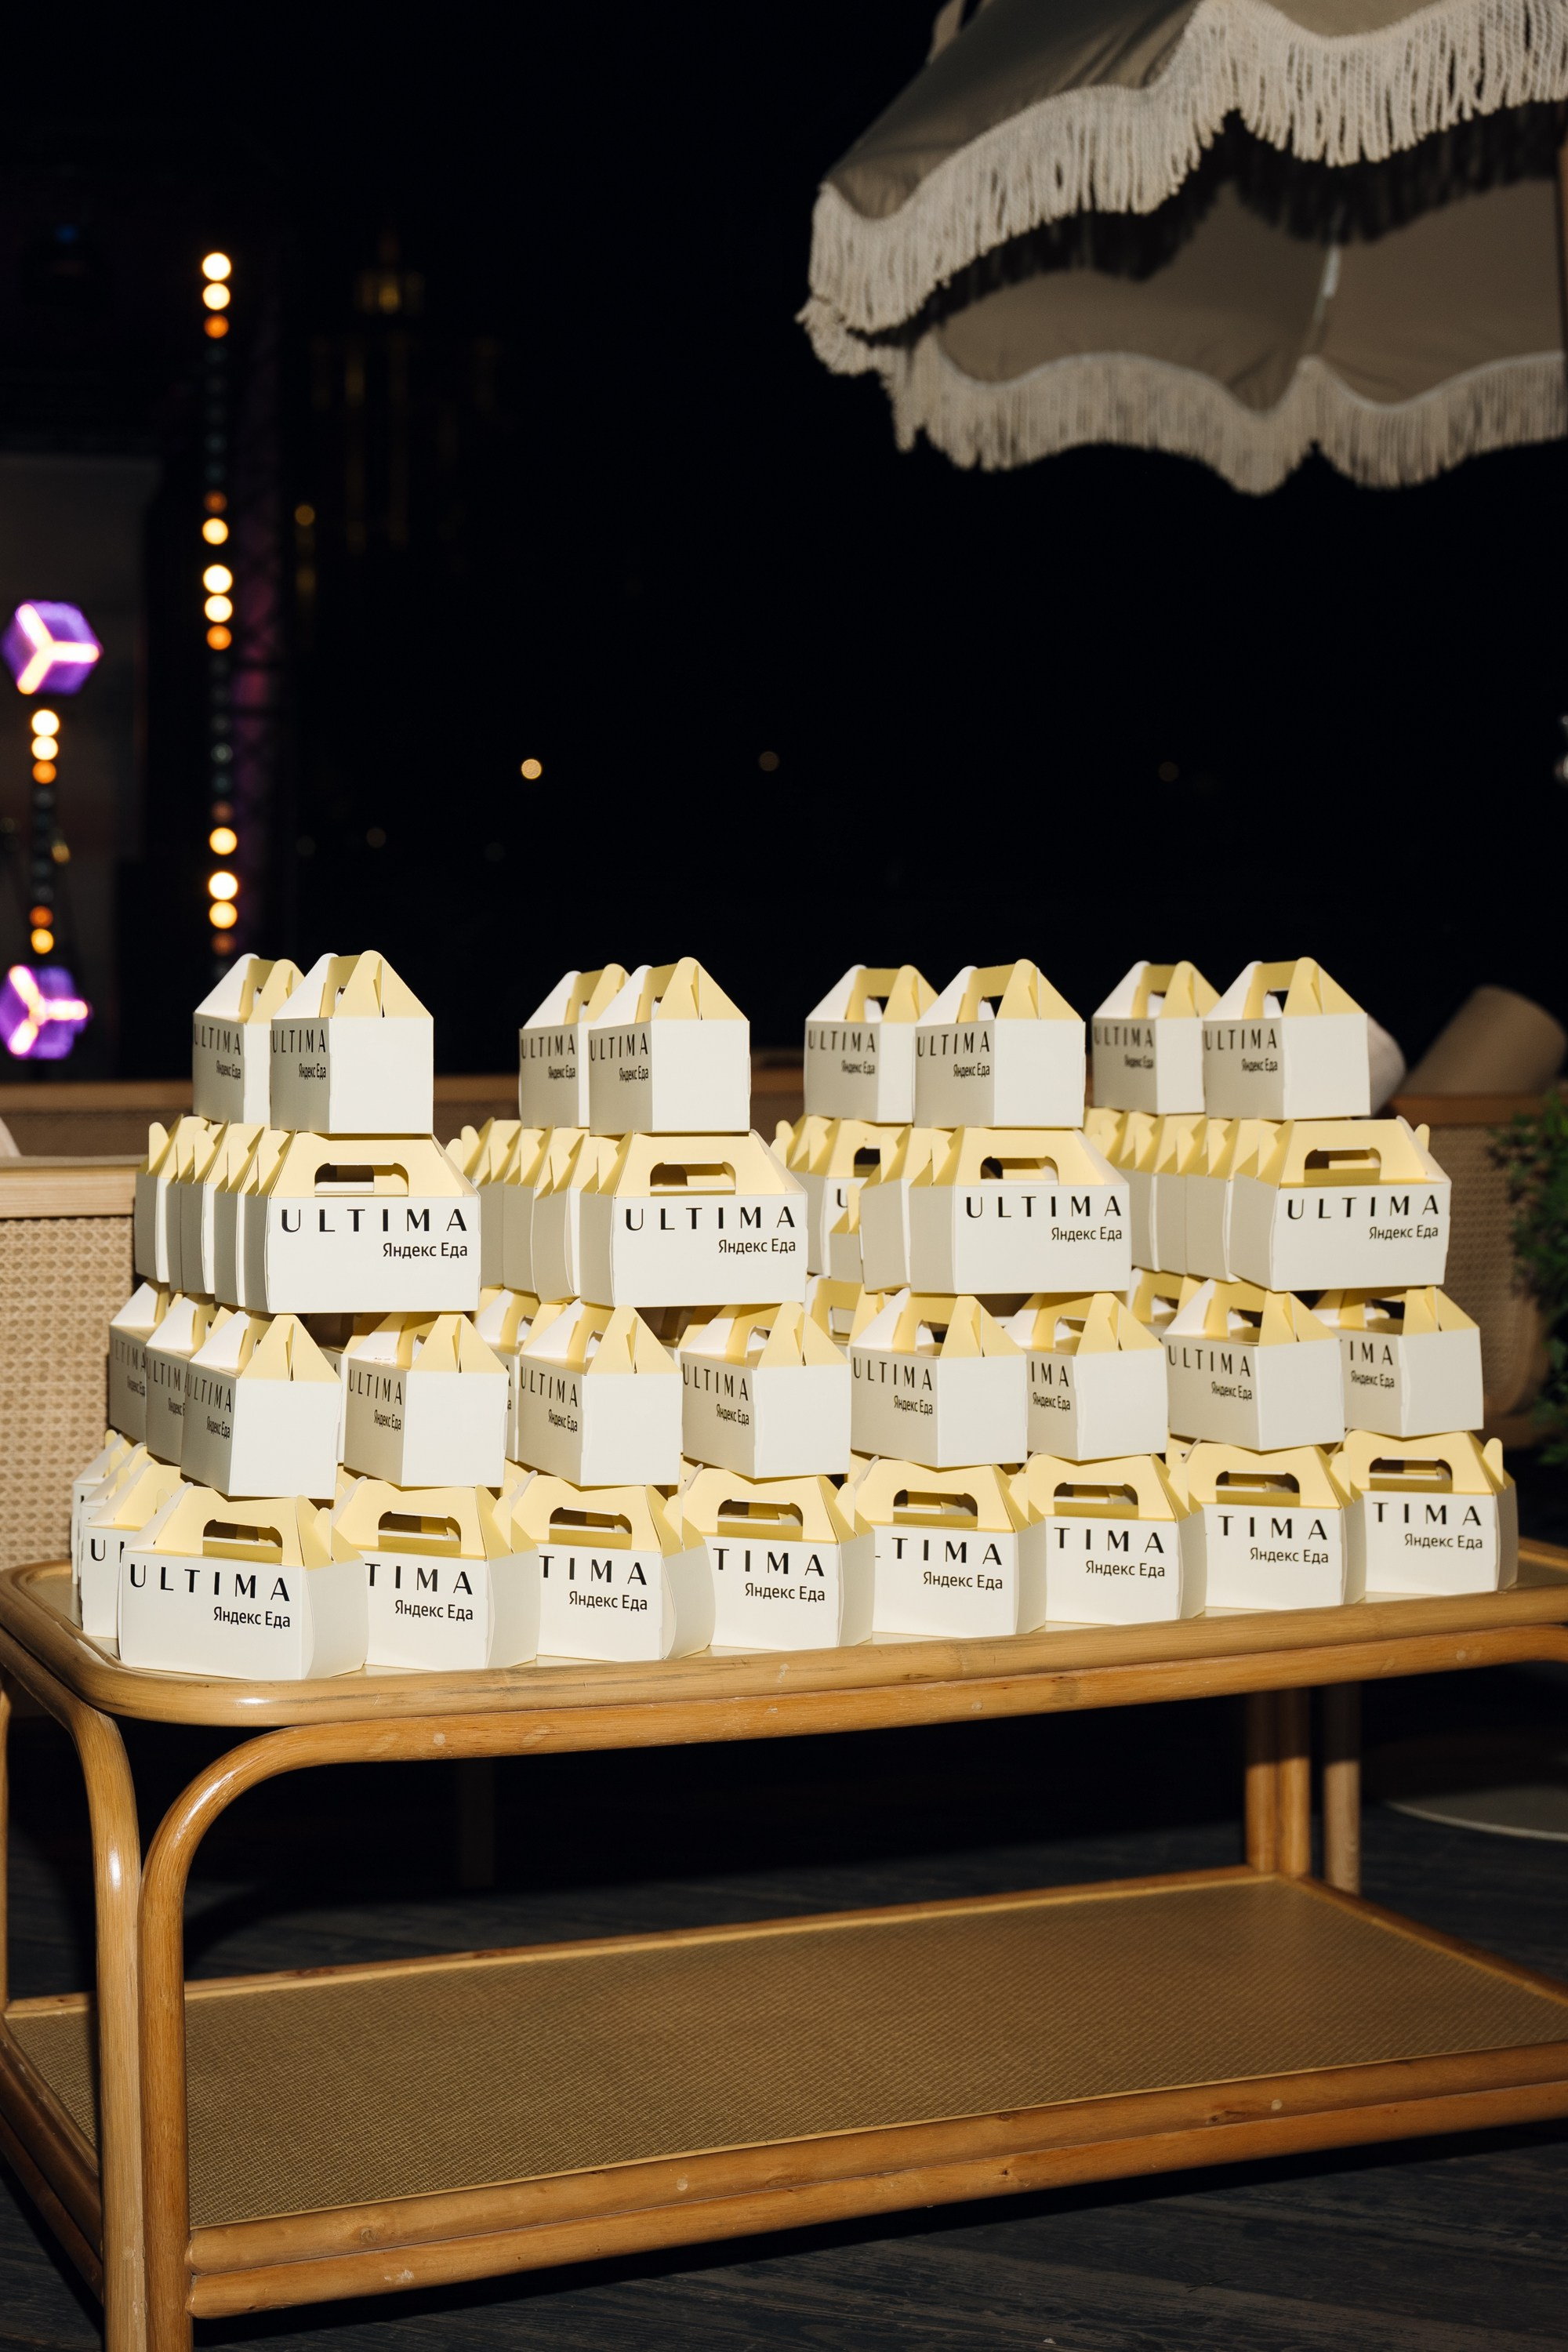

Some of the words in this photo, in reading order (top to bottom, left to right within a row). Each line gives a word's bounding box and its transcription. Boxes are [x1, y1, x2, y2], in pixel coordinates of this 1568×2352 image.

[270, 1029, 326, 1053] ULTIMA
[521, 1034, 575, 1059] ULTIMA
[590, 1033, 648, 1061] ULTIMA
[808, 1029, 876, 1053] ULTIMA
[917, 1031, 990, 1057] ULTIMA
[1203, 1028, 1277, 1051] ULTIMA
[299, 1063, 315, 1080] Яндекс
[317, 1063, 326, 1080] Еда
[619, 1067, 637, 1083] Яндекс
[638, 1065, 648, 1081] Еда
[953, 1064, 975, 1078] Яндекс
[977, 1062, 990, 1077] Еда
[625, 1206, 796, 1232] ULTIMA
[966, 1195, 1122, 1219] ULTIMA
[1287, 1194, 1439, 1220] ULTIMA
[281, 1208, 468, 1233] ULTIMA
[1369, 1226, 1414, 1241] Яндекс
[1416, 1224, 1439, 1240] Еда
[718, 1238, 768, 1255] Яндекс
[771, 1238, 797, 1254] Еда
[1051, 1227, 1097, 1243] Яндекс
[1100, 1226, 1123, 1242] Еда
[383, 1242, 437, 1260] Яндекс
[441, 1242, 468, 1259] Еда
[1168, 1345, 1251, 1377] ULTIMA
[1349, 1341, 1393, 1366] IMA
[147, 1357, 187, 1392] ULTIM
[682, 1363, 749, 1401] ULTIMA
[853, 1357, 933, 1391] ULTIMA
[1032, 1361, 1069, 1387] IMA
[186, 1374, 231, 1413] ULTIMA
[349, 1369, 402, 1405] ULTIMA
[521, 1366, 578, 1407] ULTIMA
[1211, 1381, 1236, 1399] Яндекс
[1239, 1385, 1252, 1401] Еда
[894, 1396, 918, 1414] Яндекс
[920, 1399, 933, 1415] Еда
[1033, 1392, 1056, 1409] Яндекс
[1058, 1396, 1070, 1412] Еда
[374, 1410, 390, 1428] Яндекс
[392, 1414, 401, 1431] Еда
[548, 1409, 566, 1428] Яндекс
[567, 1415, 578, 1432] Еда
[717, 1403, 737, 1423] Яндекс
[738, 1409, 750, 1426] Еда
[1372, 1501, 1483, 1526] TIMA
[1053, 1526, 1165, 1554] TIMA
[1218, 1515, 1328, 1541] TIMA
[875, 1537, 1003, 1566] TIMA
[1404, 1533, 1454, 1549] Яндекс
[1457, 1534, 1483, 1551] Еда
[712, 1548, 825, 1577] TIMA
[1250, 1547, 1299, 1563] Яндекс
[1303, 1548, 1329, 1565] Еда
[365, 1563, 474, 1595] TIMA
[539, 1555, 648, 1586] TIMA
[1085, 1559, 1135, 1577] Яндекс
[1139, 1562, 1165, 1579] Еда
[129, 1563, 290, 1602] ULTIMA
[745, 1582, 796, 1600] Яндекс
[799, 1585, 826, 1603] Еда
[923, 1571, 974, 1588] Яндекс
[977, 1574, 1003, 1592] Еда
[394, 1599, 444, 1619] Яндекс
[448, 1603, 474, 1622] Еда
[568, 1590, 619, 1609] Яндекс
[622, 1594, 648, 1613] Еда
[213, 1606, 262, 1626] Яндекс
[265, 1611, 291, 1629] Еда
